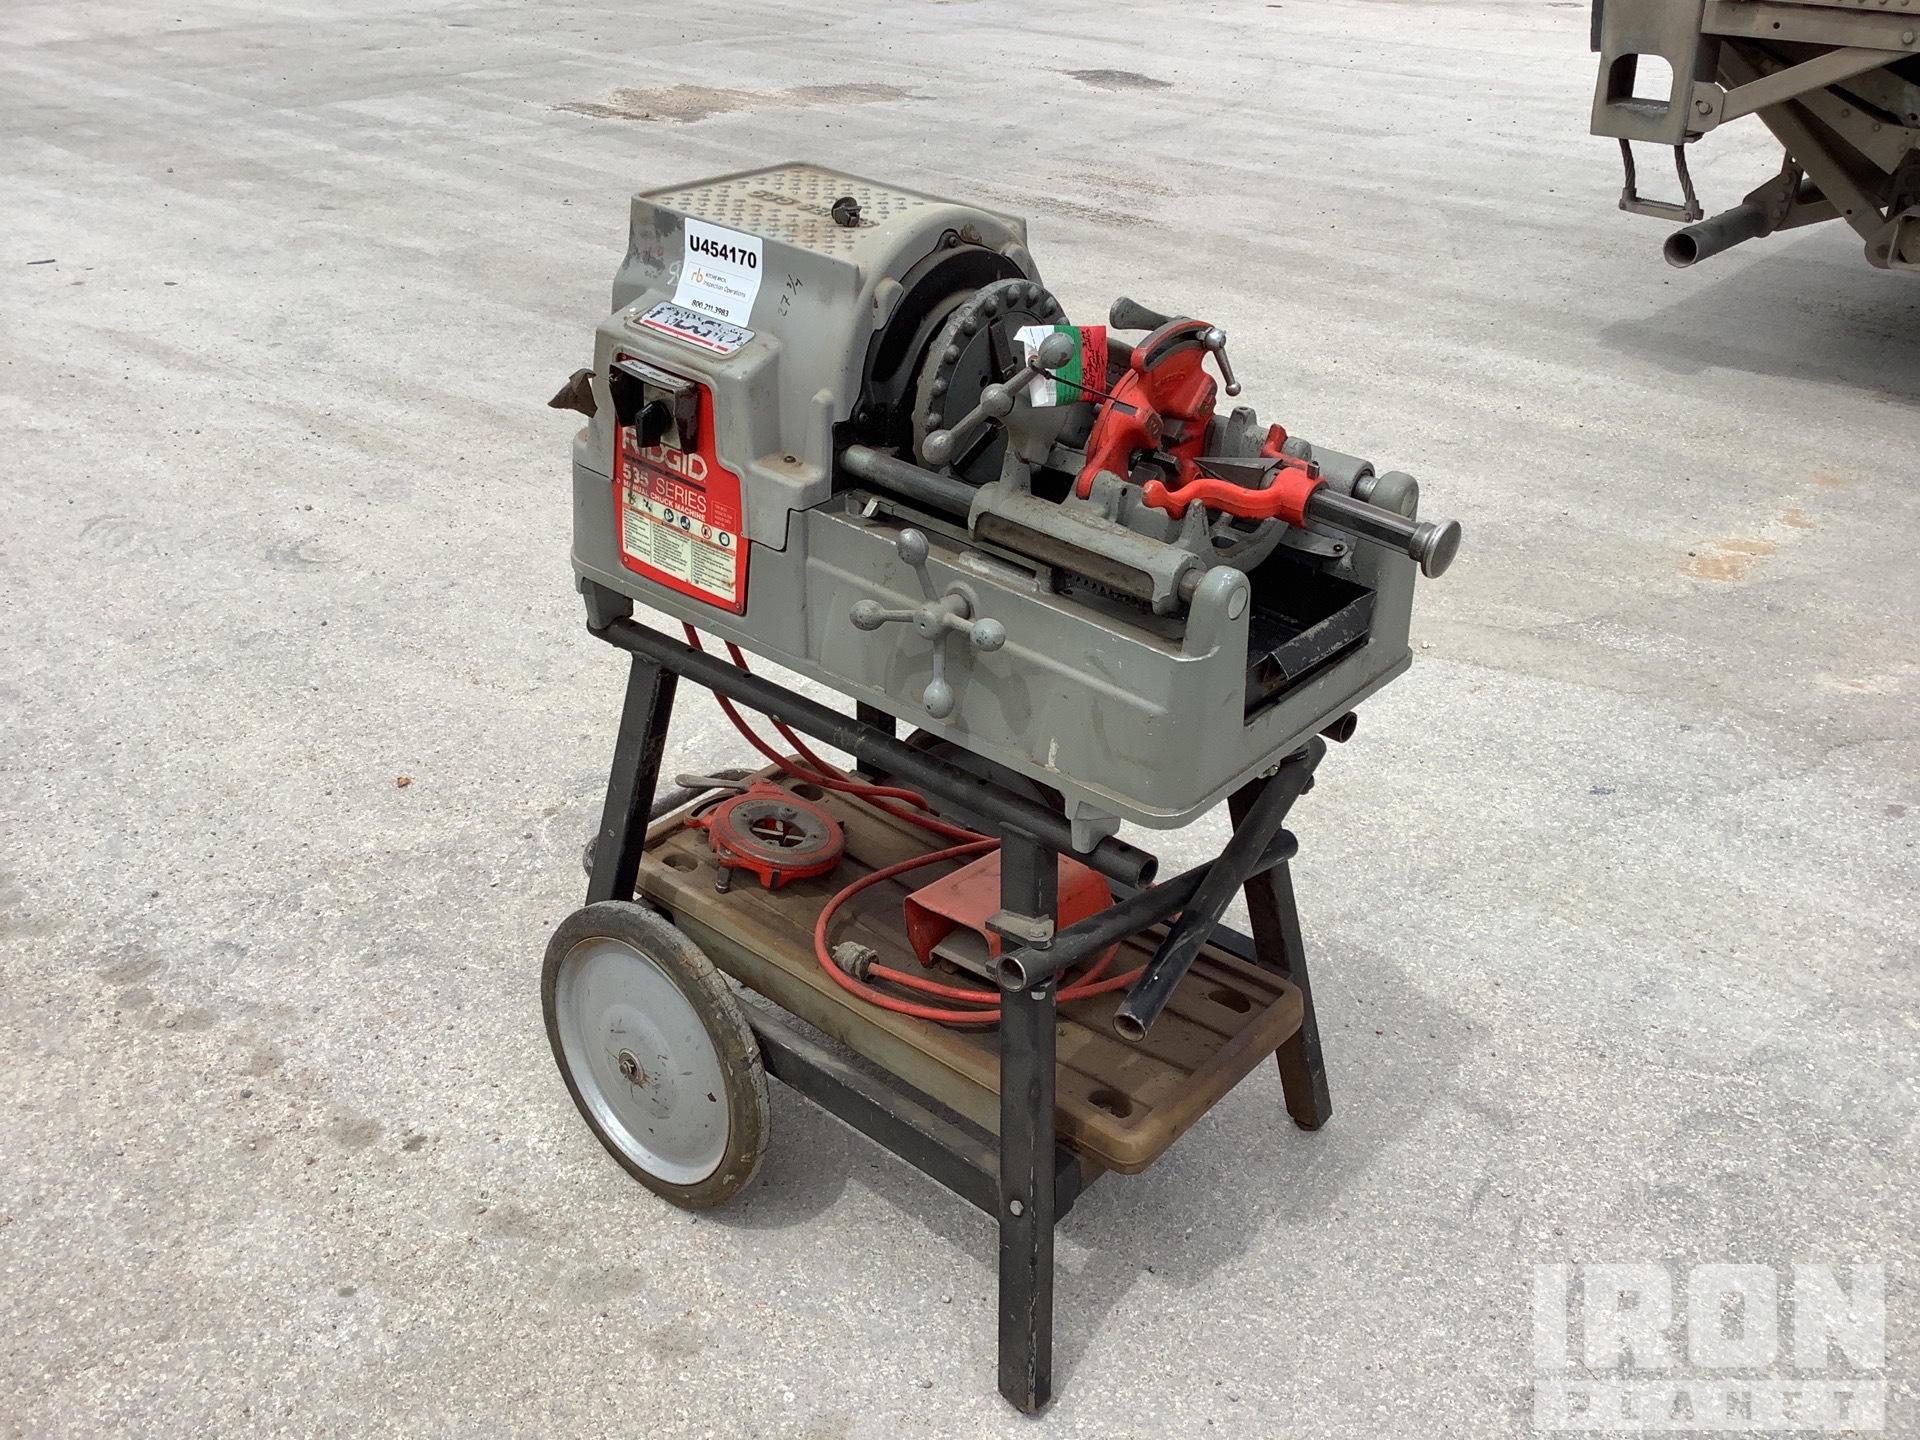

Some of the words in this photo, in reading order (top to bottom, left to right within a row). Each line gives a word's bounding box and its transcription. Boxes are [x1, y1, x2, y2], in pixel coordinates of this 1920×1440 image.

[689, 234, 757, 269] U454170
[702, 280, 724, 293] Inspection
[724, 286, 746, 299] Operations
[691, 299, 730, 318] 800.211.3983
[622, 463, 649, 488] 535
[649, 491, 674, 508] CHUCK
[674, 502, 706, 522] MACHINE
[655, 476, 707, 513] SERIES
